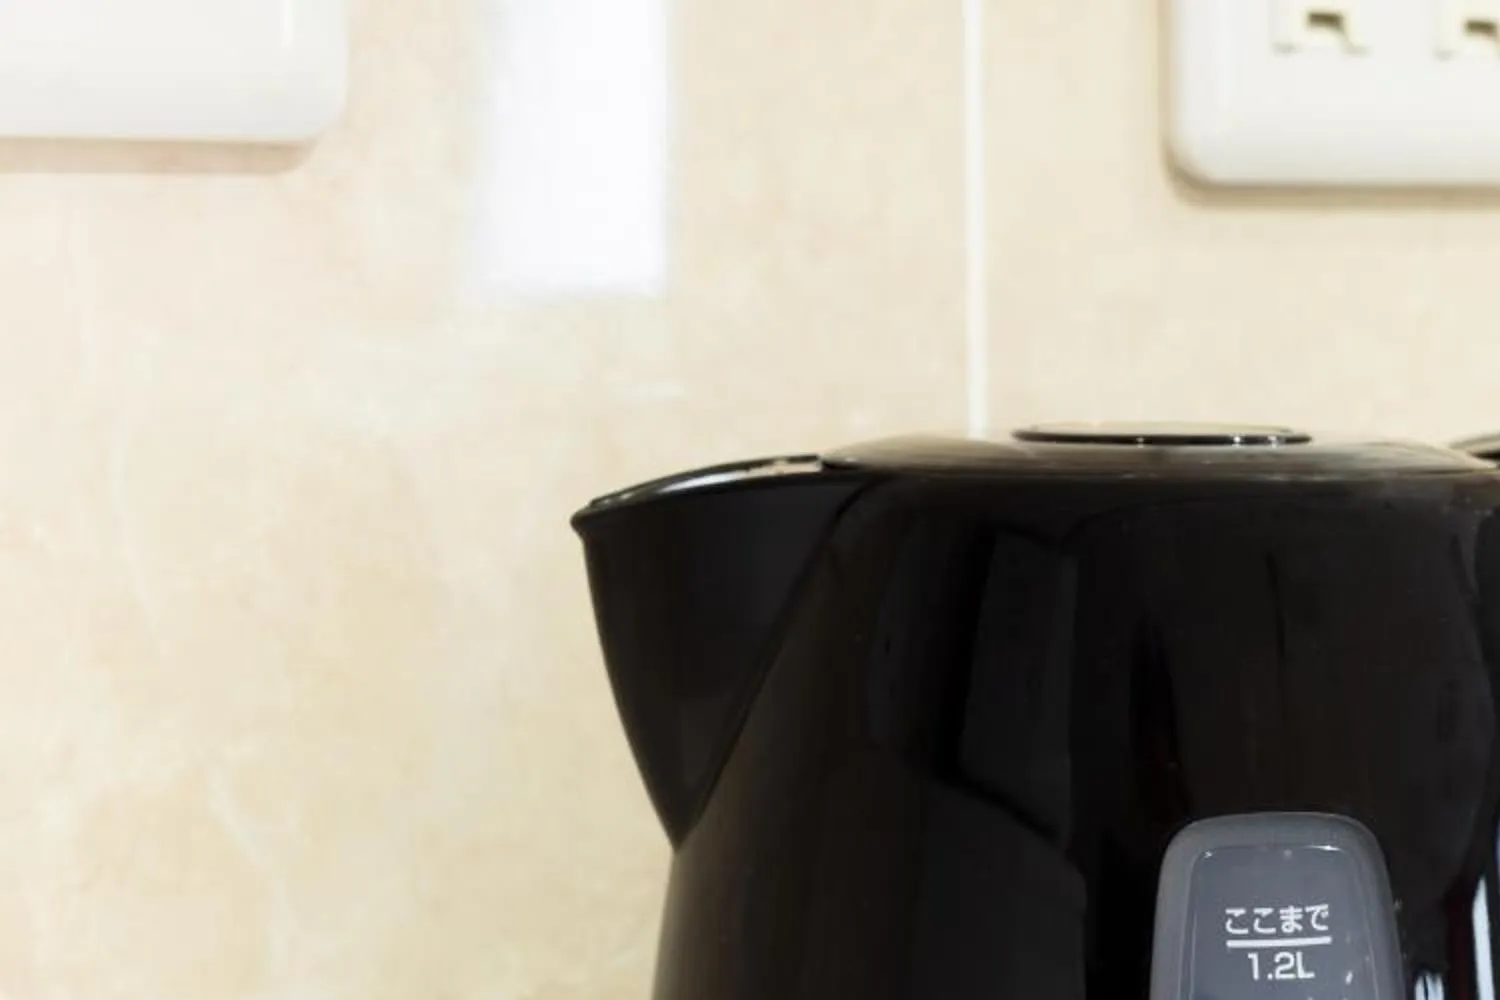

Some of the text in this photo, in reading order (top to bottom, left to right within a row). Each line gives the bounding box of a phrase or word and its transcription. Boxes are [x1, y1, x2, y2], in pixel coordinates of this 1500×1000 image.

[1225, 904, 1330, 935] ここまで
[1247, 951, 1316, 981] 1.2L
